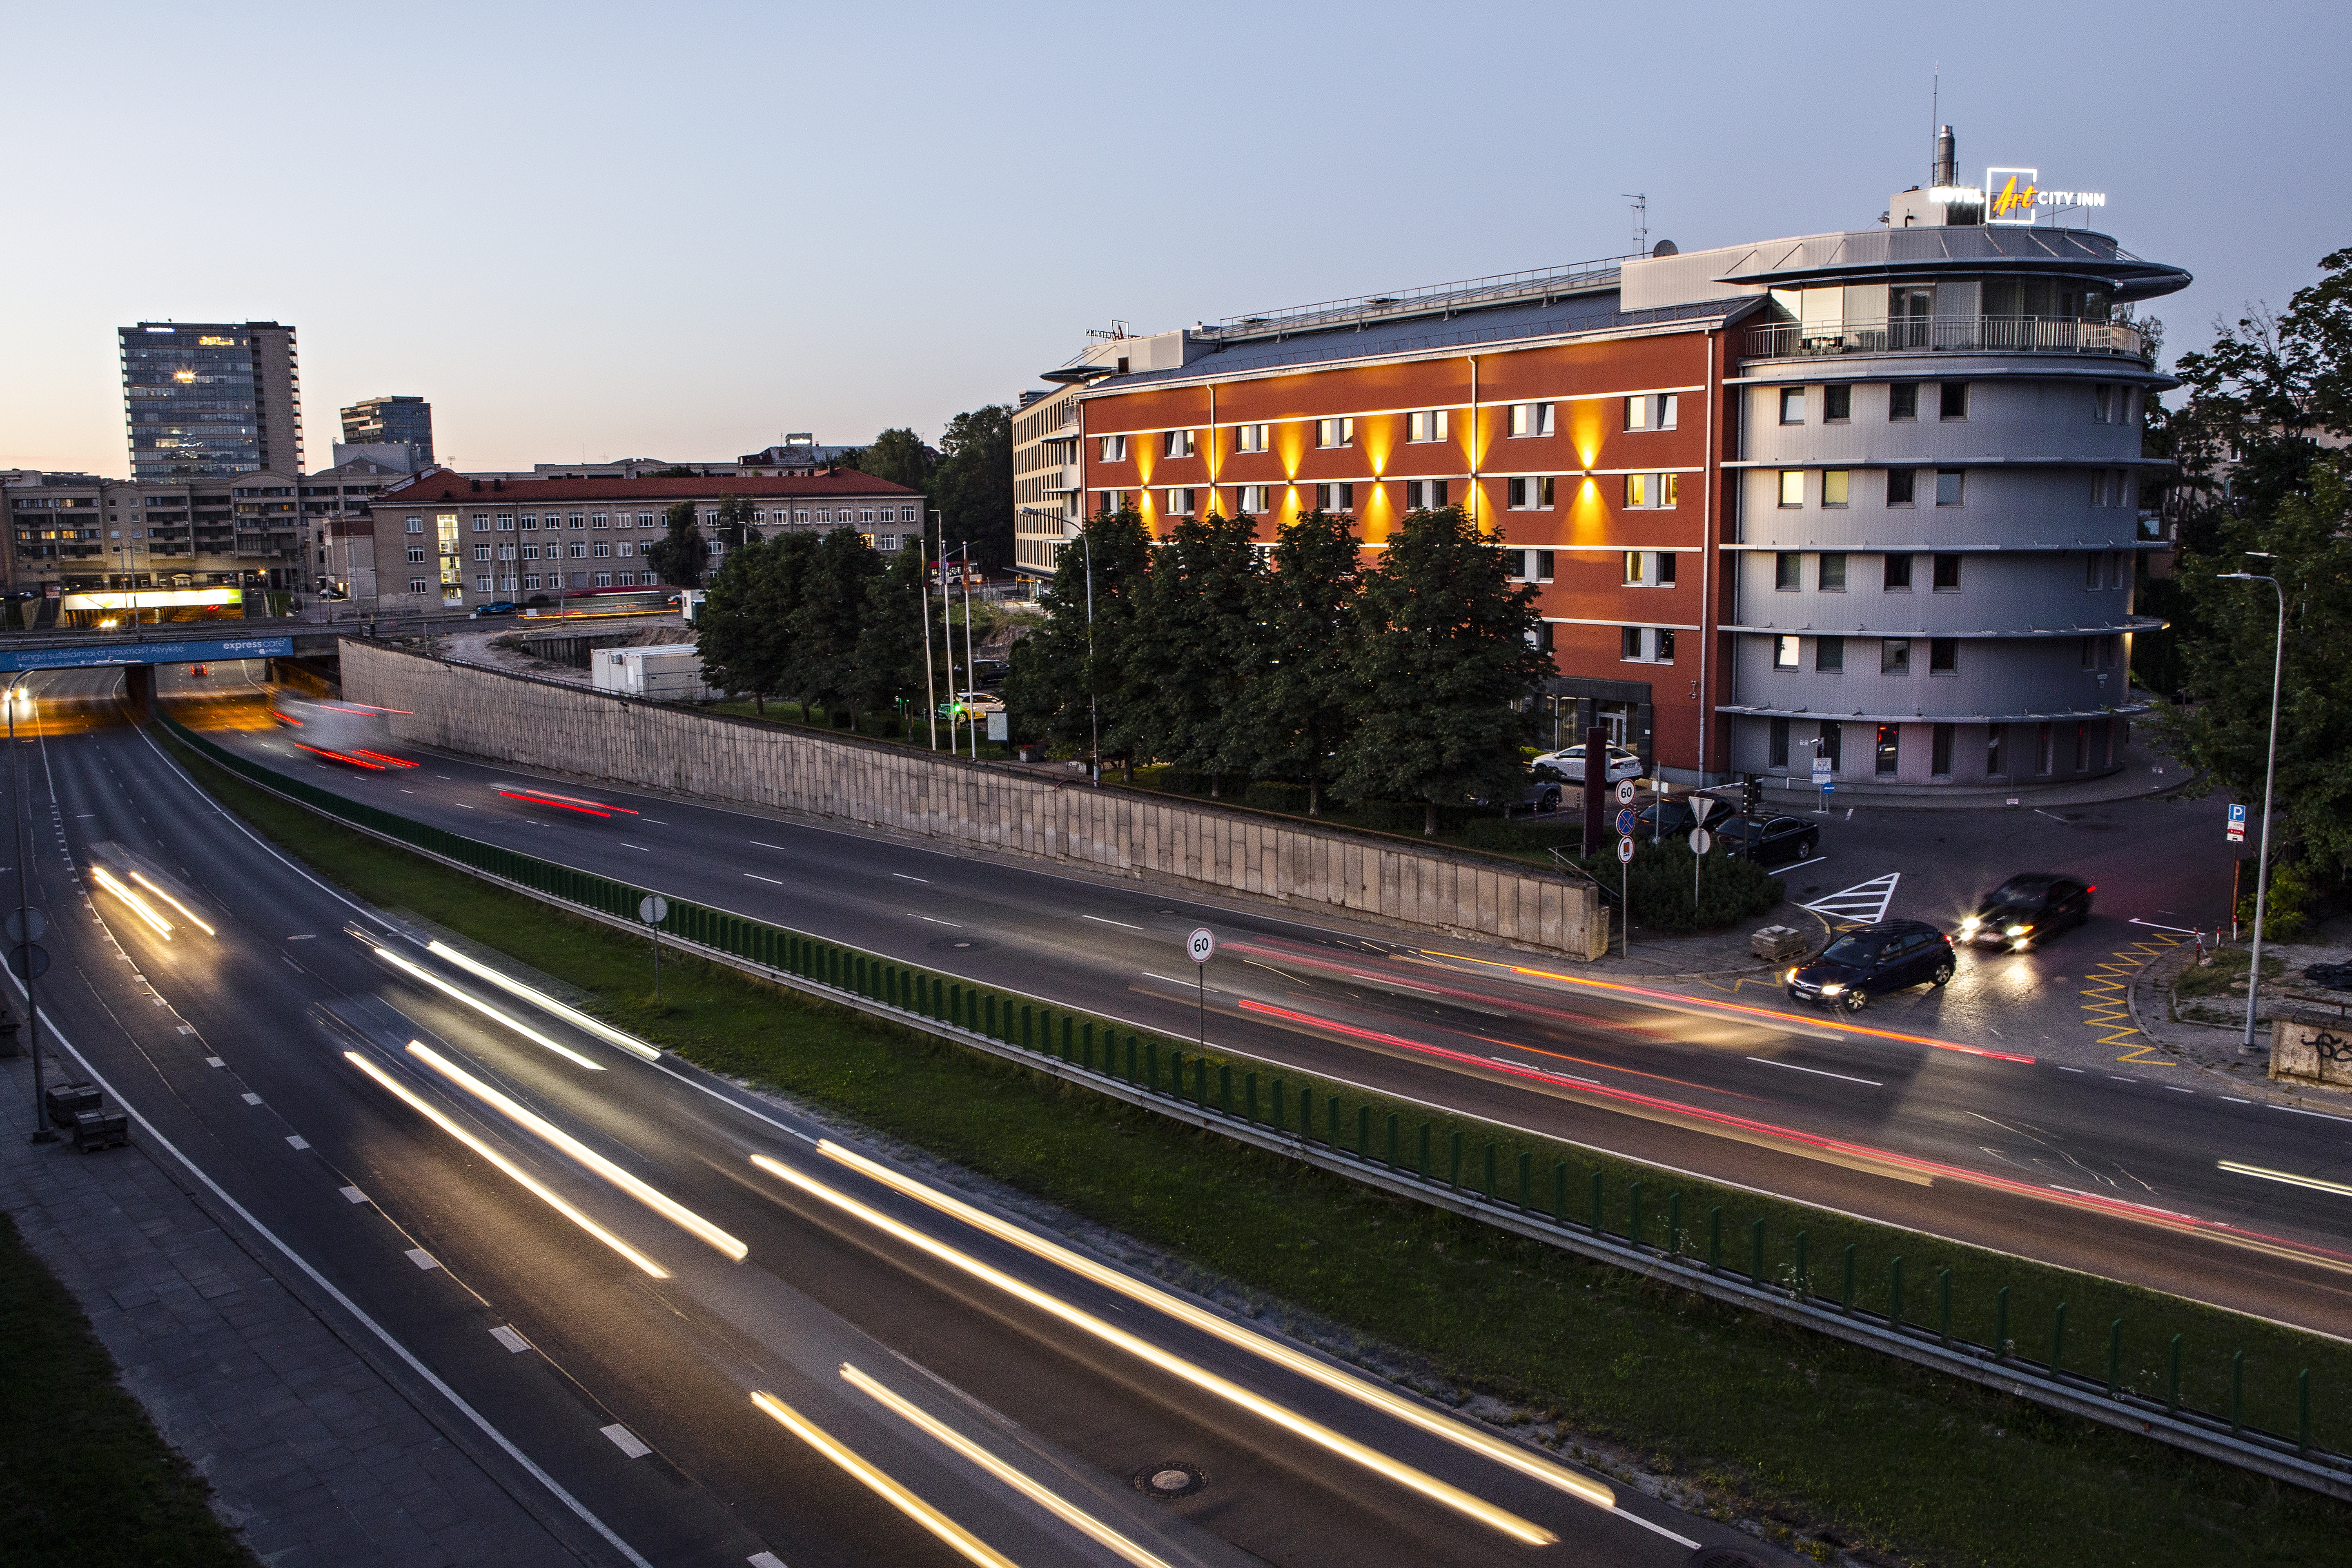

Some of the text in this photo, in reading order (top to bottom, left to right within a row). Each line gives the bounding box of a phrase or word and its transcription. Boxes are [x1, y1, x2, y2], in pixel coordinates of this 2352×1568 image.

[1993, 176, 2038, 216] Art
[2037, 192, 2074, 205] CITY
[2076, 192, 2105, 207] INN
[1621, 787, 1632, 798] 60
[2233, 806, 2243, 819] P
[1194, 938, 1208, 952] 60
